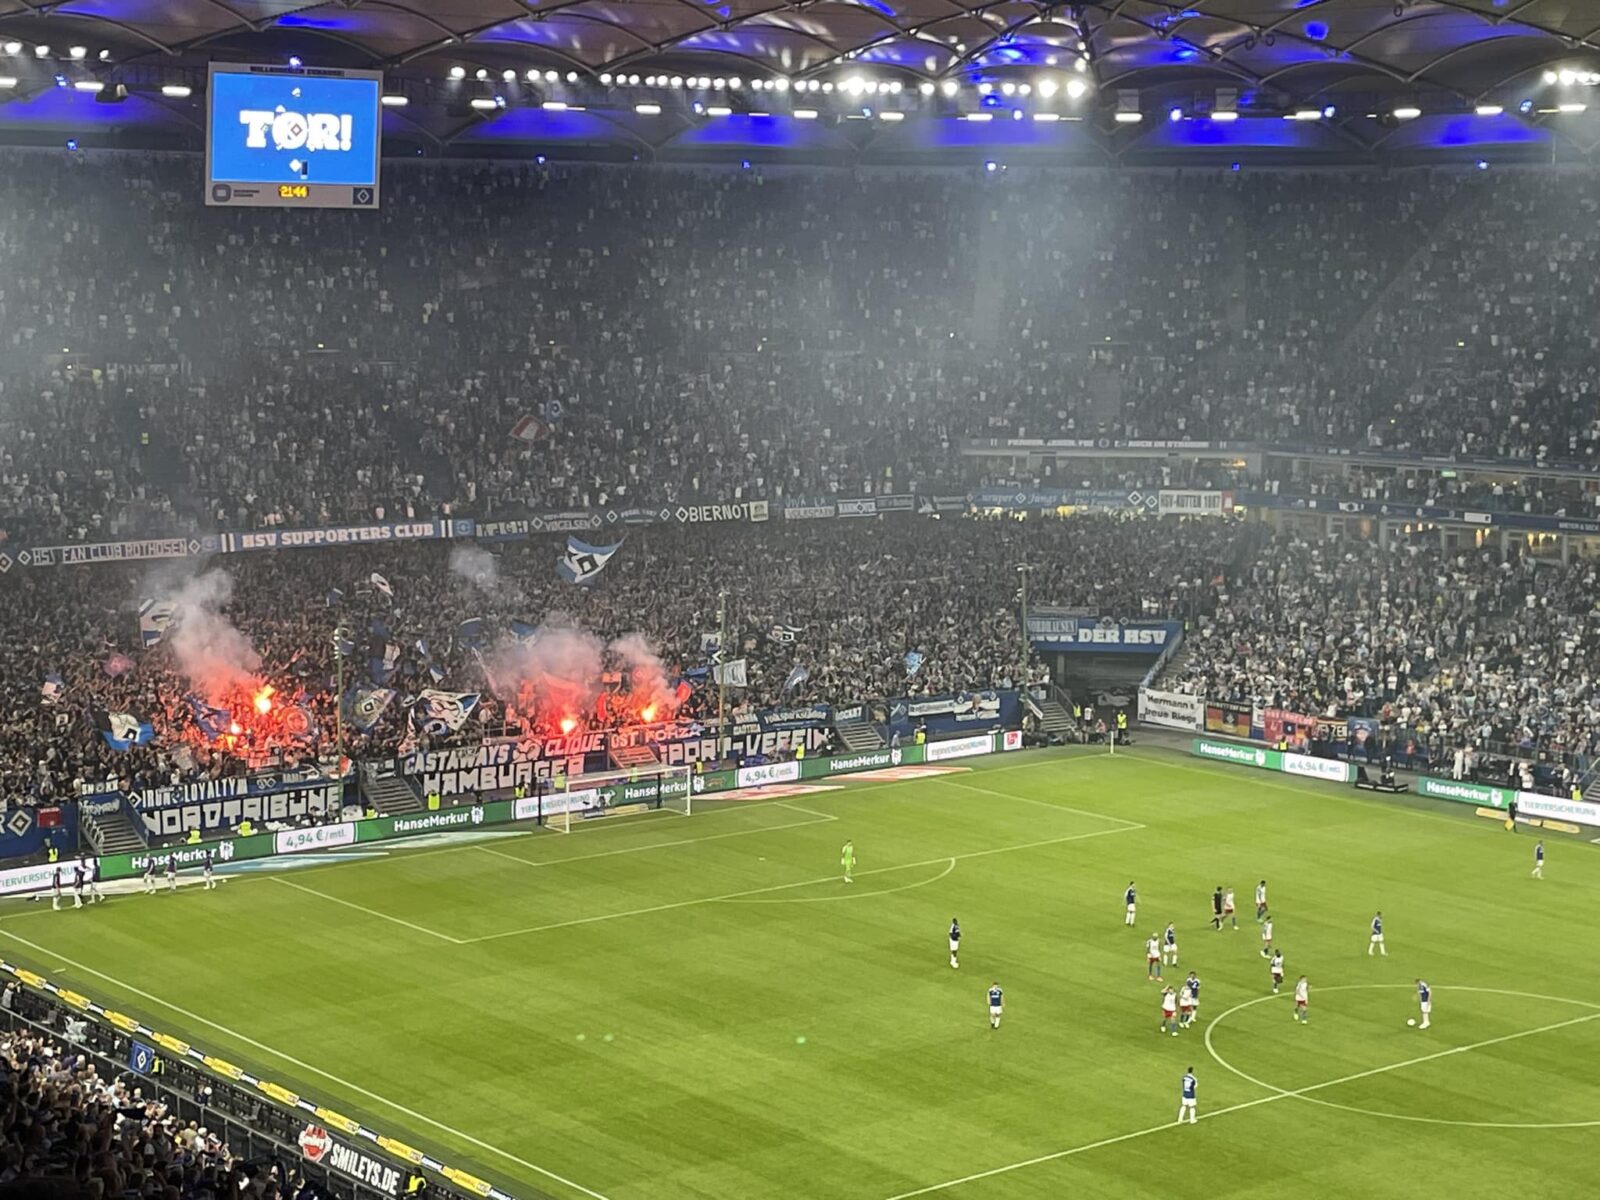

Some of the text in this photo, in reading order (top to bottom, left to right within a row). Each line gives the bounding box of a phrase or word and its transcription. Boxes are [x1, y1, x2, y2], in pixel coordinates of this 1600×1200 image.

[239, 105, 353, 151] TOR!
[689, 502, 749, 522] BIERNOT
[243, 523, 434, 549] HSV SUPPORTERS CLUB
[63, 548, 88, 564] FAN
[90, 545, 122, 561] CLUB
[127, 540, 186, 558] ROTHOSEN
[1078, 628, 1120, 644] DER
[1124, 629, 1167, 645] HSV
[545, 733, 604, 757] CLIQUE
[1200, 742, 1256, 761] HanseMerkur
[404, 744, 510, 775] CASTAWAYS
[830, 752, 890, 771] HanseMerkur
[745, 770, 767, 783] 4,94
[184, 778, 236, 802] LOYALTY
[625, 780, 691, 799] HanseMerku
[1426, 780, 1490, 801] HanseMerkur
[141, 786, 341, 835] NORDTRIBÜNE
[394, 811, 470, 832] HanseMerkur
[286, 833, 313, 849] 4,94
[330, 1142, 400, 1195] SMILEYS.DE
